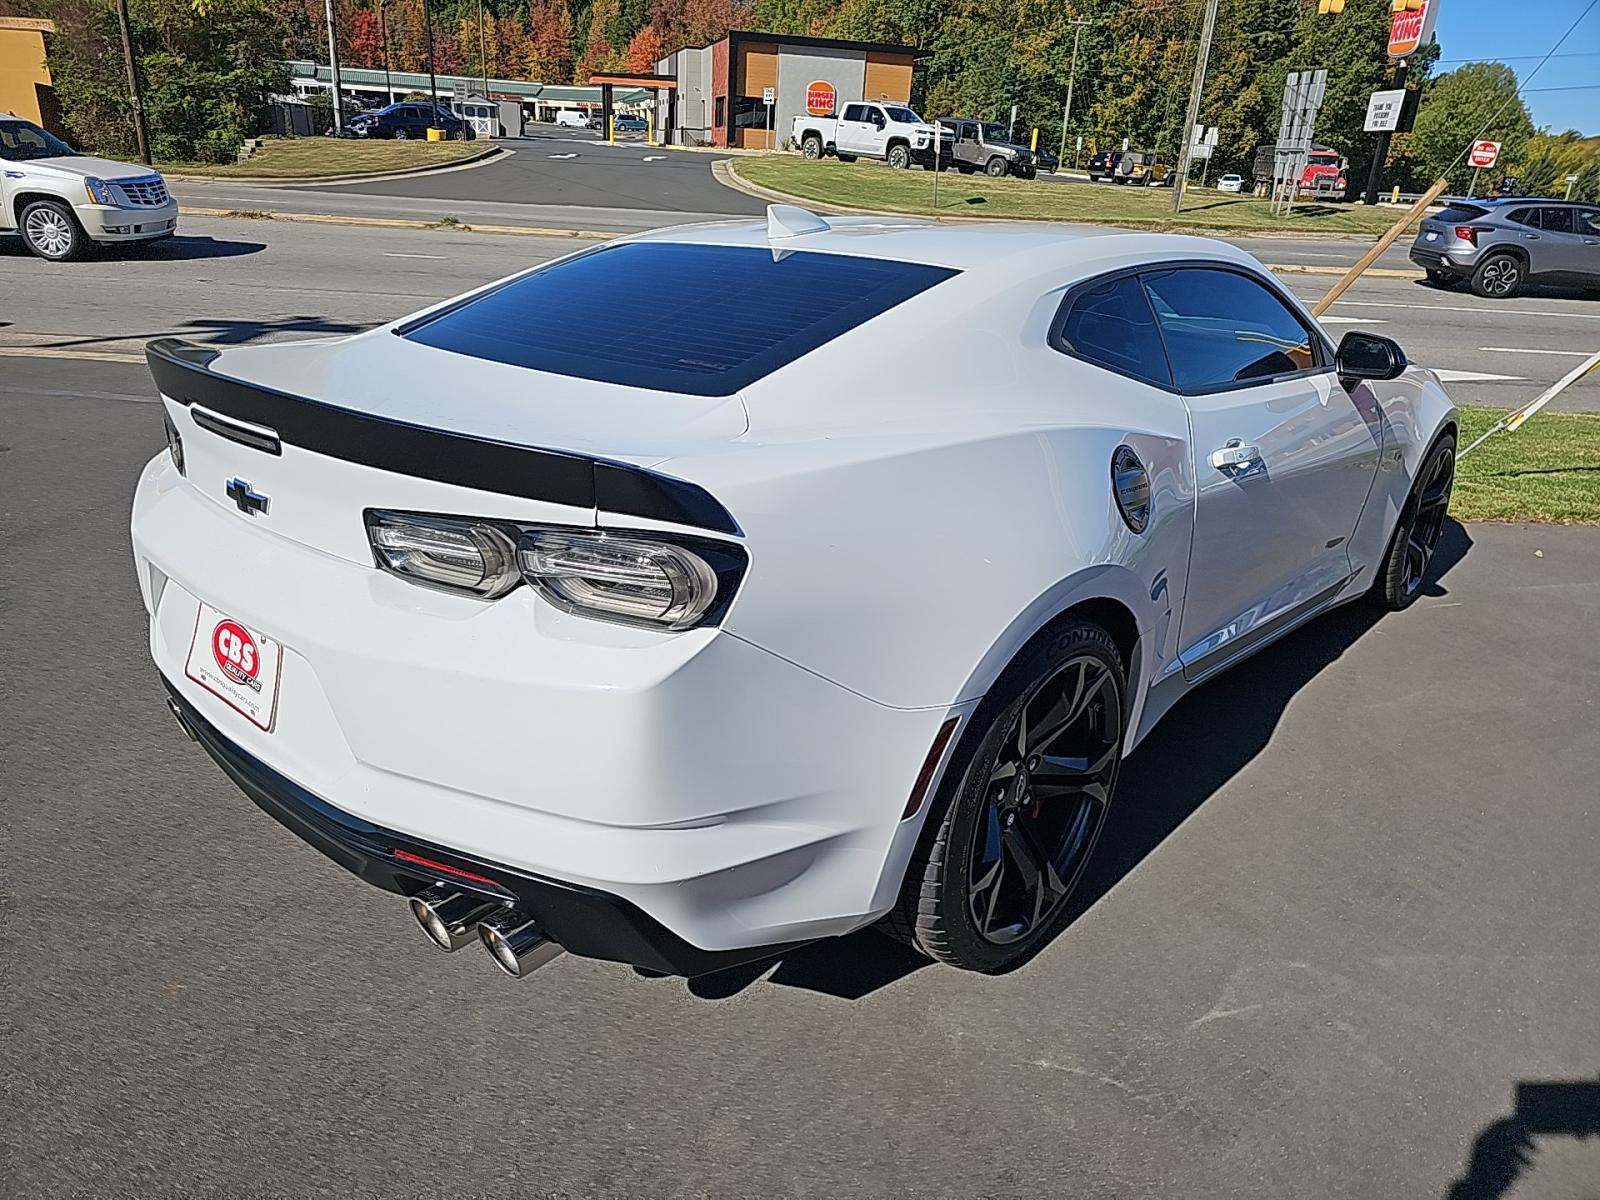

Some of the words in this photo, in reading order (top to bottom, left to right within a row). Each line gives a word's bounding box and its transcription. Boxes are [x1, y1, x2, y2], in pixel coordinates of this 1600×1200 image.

[1390, 18, 1421, 42] KING
[807, 91, 834, 99] BURGER
[807, 98, 834, 109] KING
[218, 628, 254, 672] CBS
